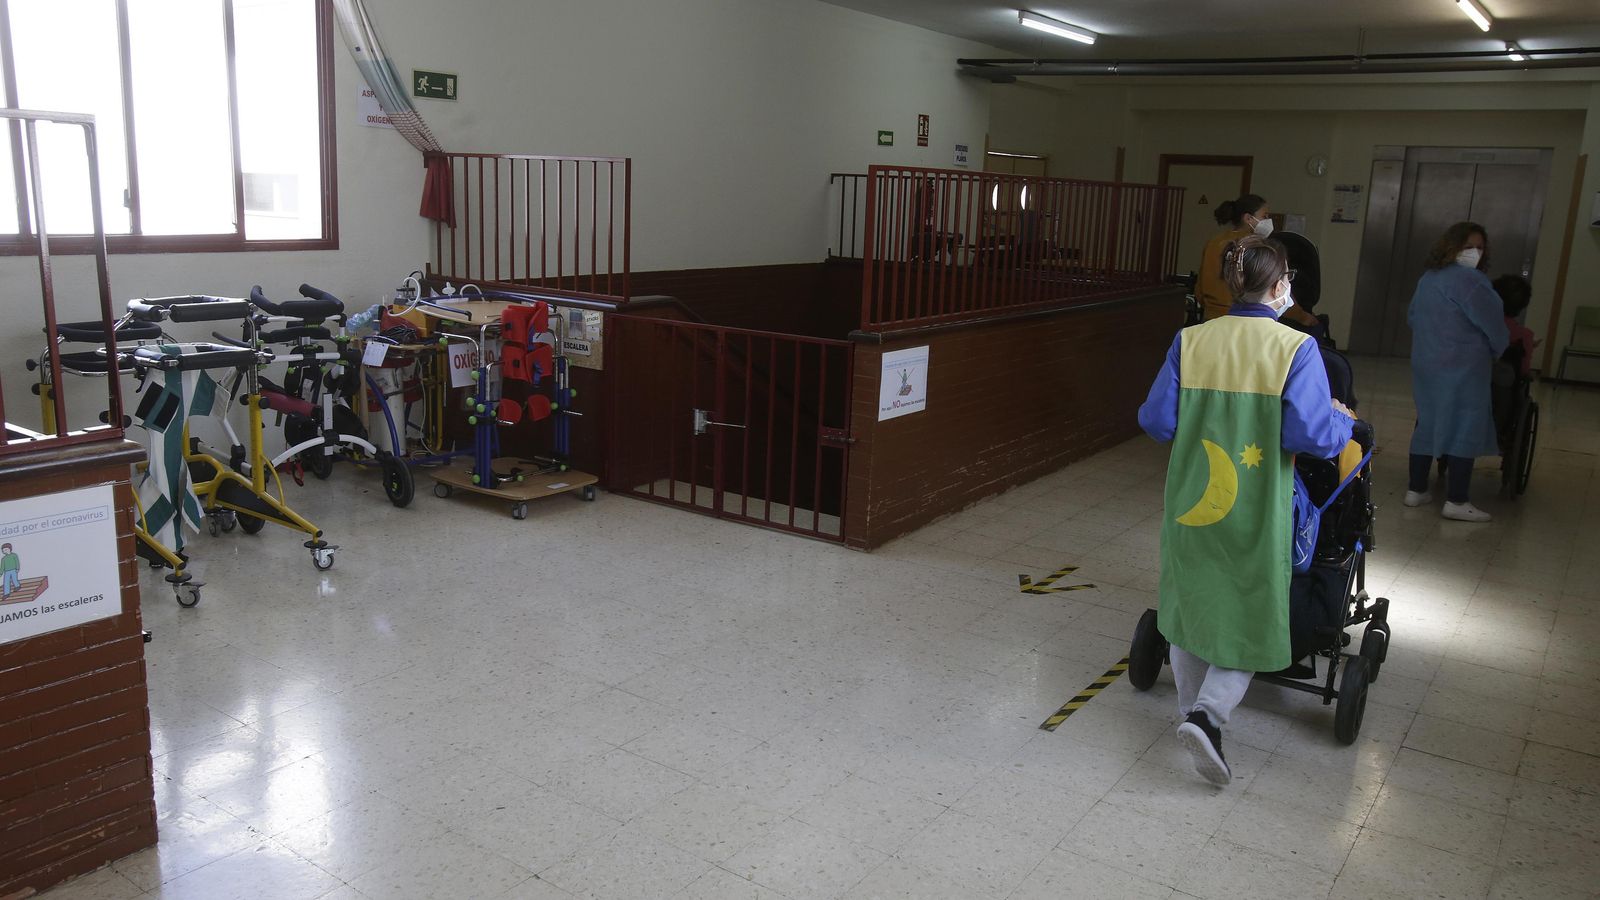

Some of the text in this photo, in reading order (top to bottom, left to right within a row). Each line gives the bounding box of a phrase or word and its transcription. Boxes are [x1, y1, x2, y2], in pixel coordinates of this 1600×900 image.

[564, 342, 589, 352] ESCALERA
[893, 400, 901, 409] NO
[22, 522, 38, 533] por
[41, 519, 50, 529] el
[52, 511, 104, 526] coronavirus
[41, 605, 56, 614] las
[58, 594, 104, 610] escaleras
